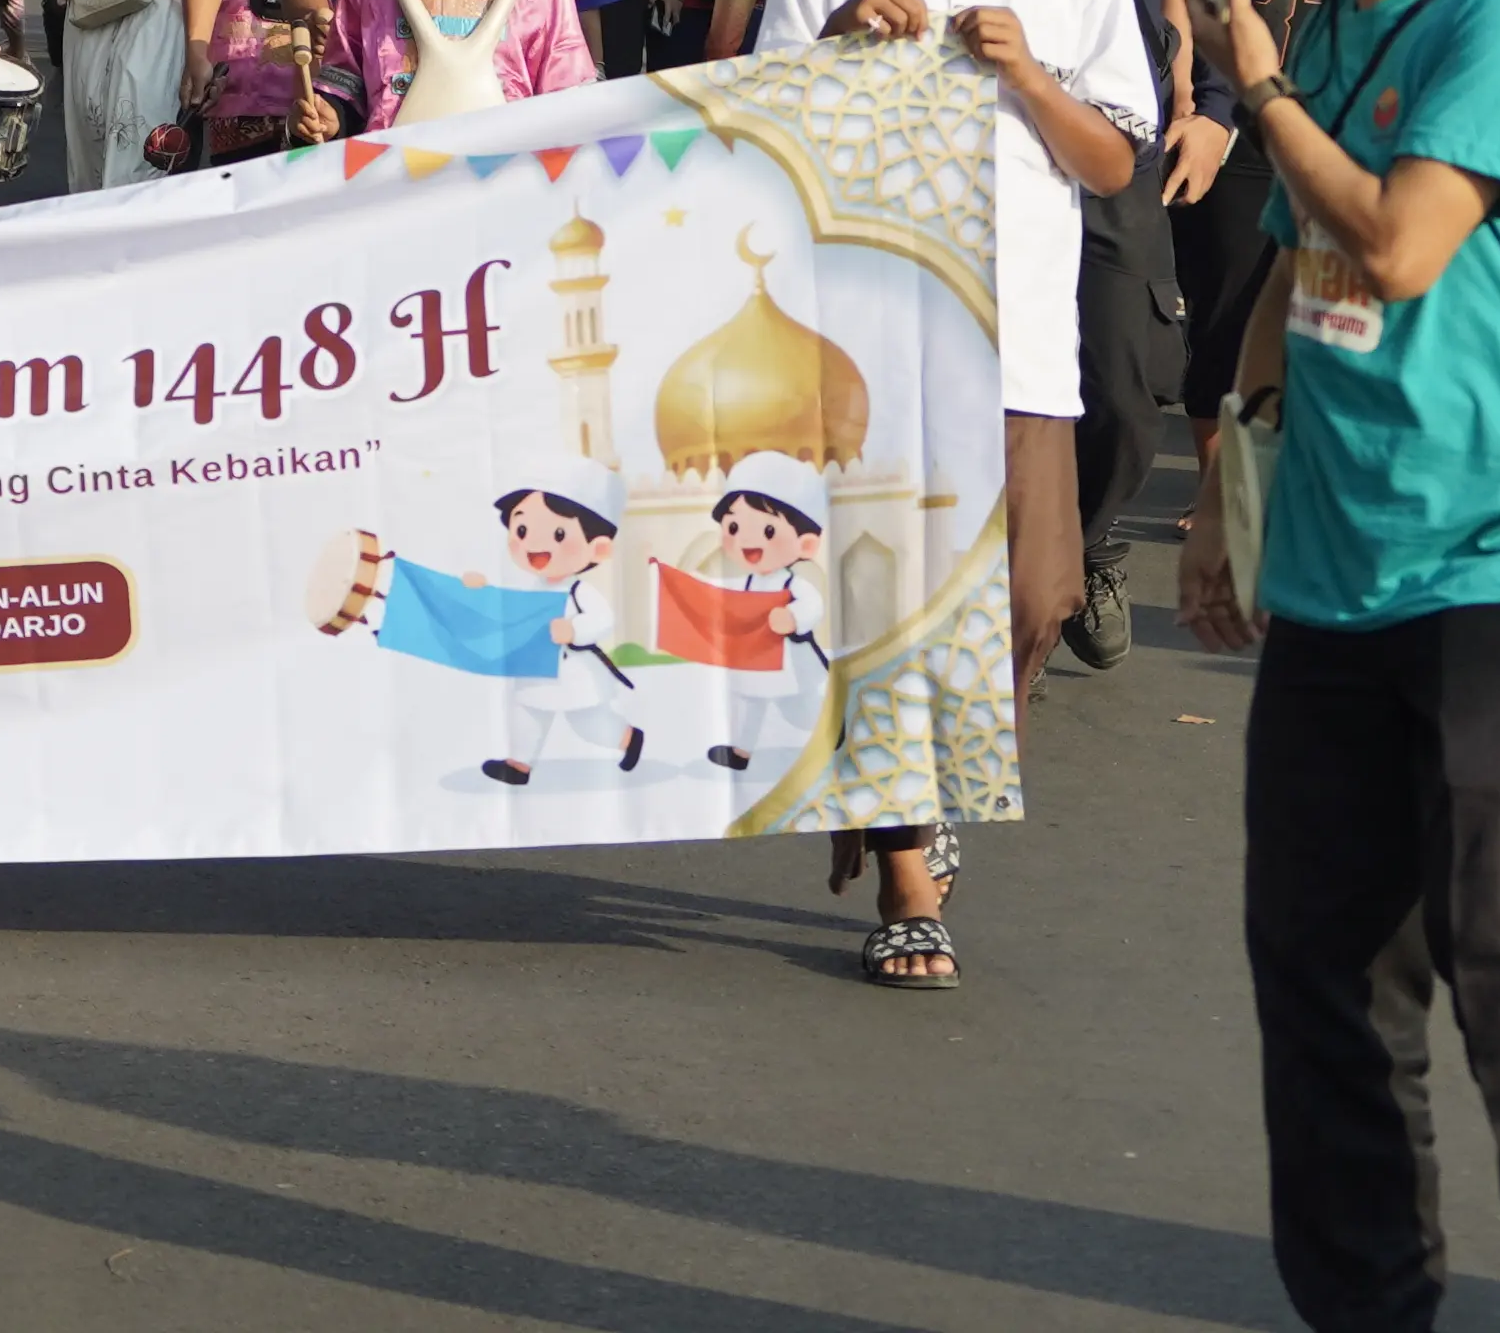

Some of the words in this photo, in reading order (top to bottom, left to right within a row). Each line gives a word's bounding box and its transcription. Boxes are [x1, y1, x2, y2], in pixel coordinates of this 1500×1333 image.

[122, 302, 358, 425] 1448
[389, 259, 512, 403] H
[46, 462, 156, 496] Cinta
